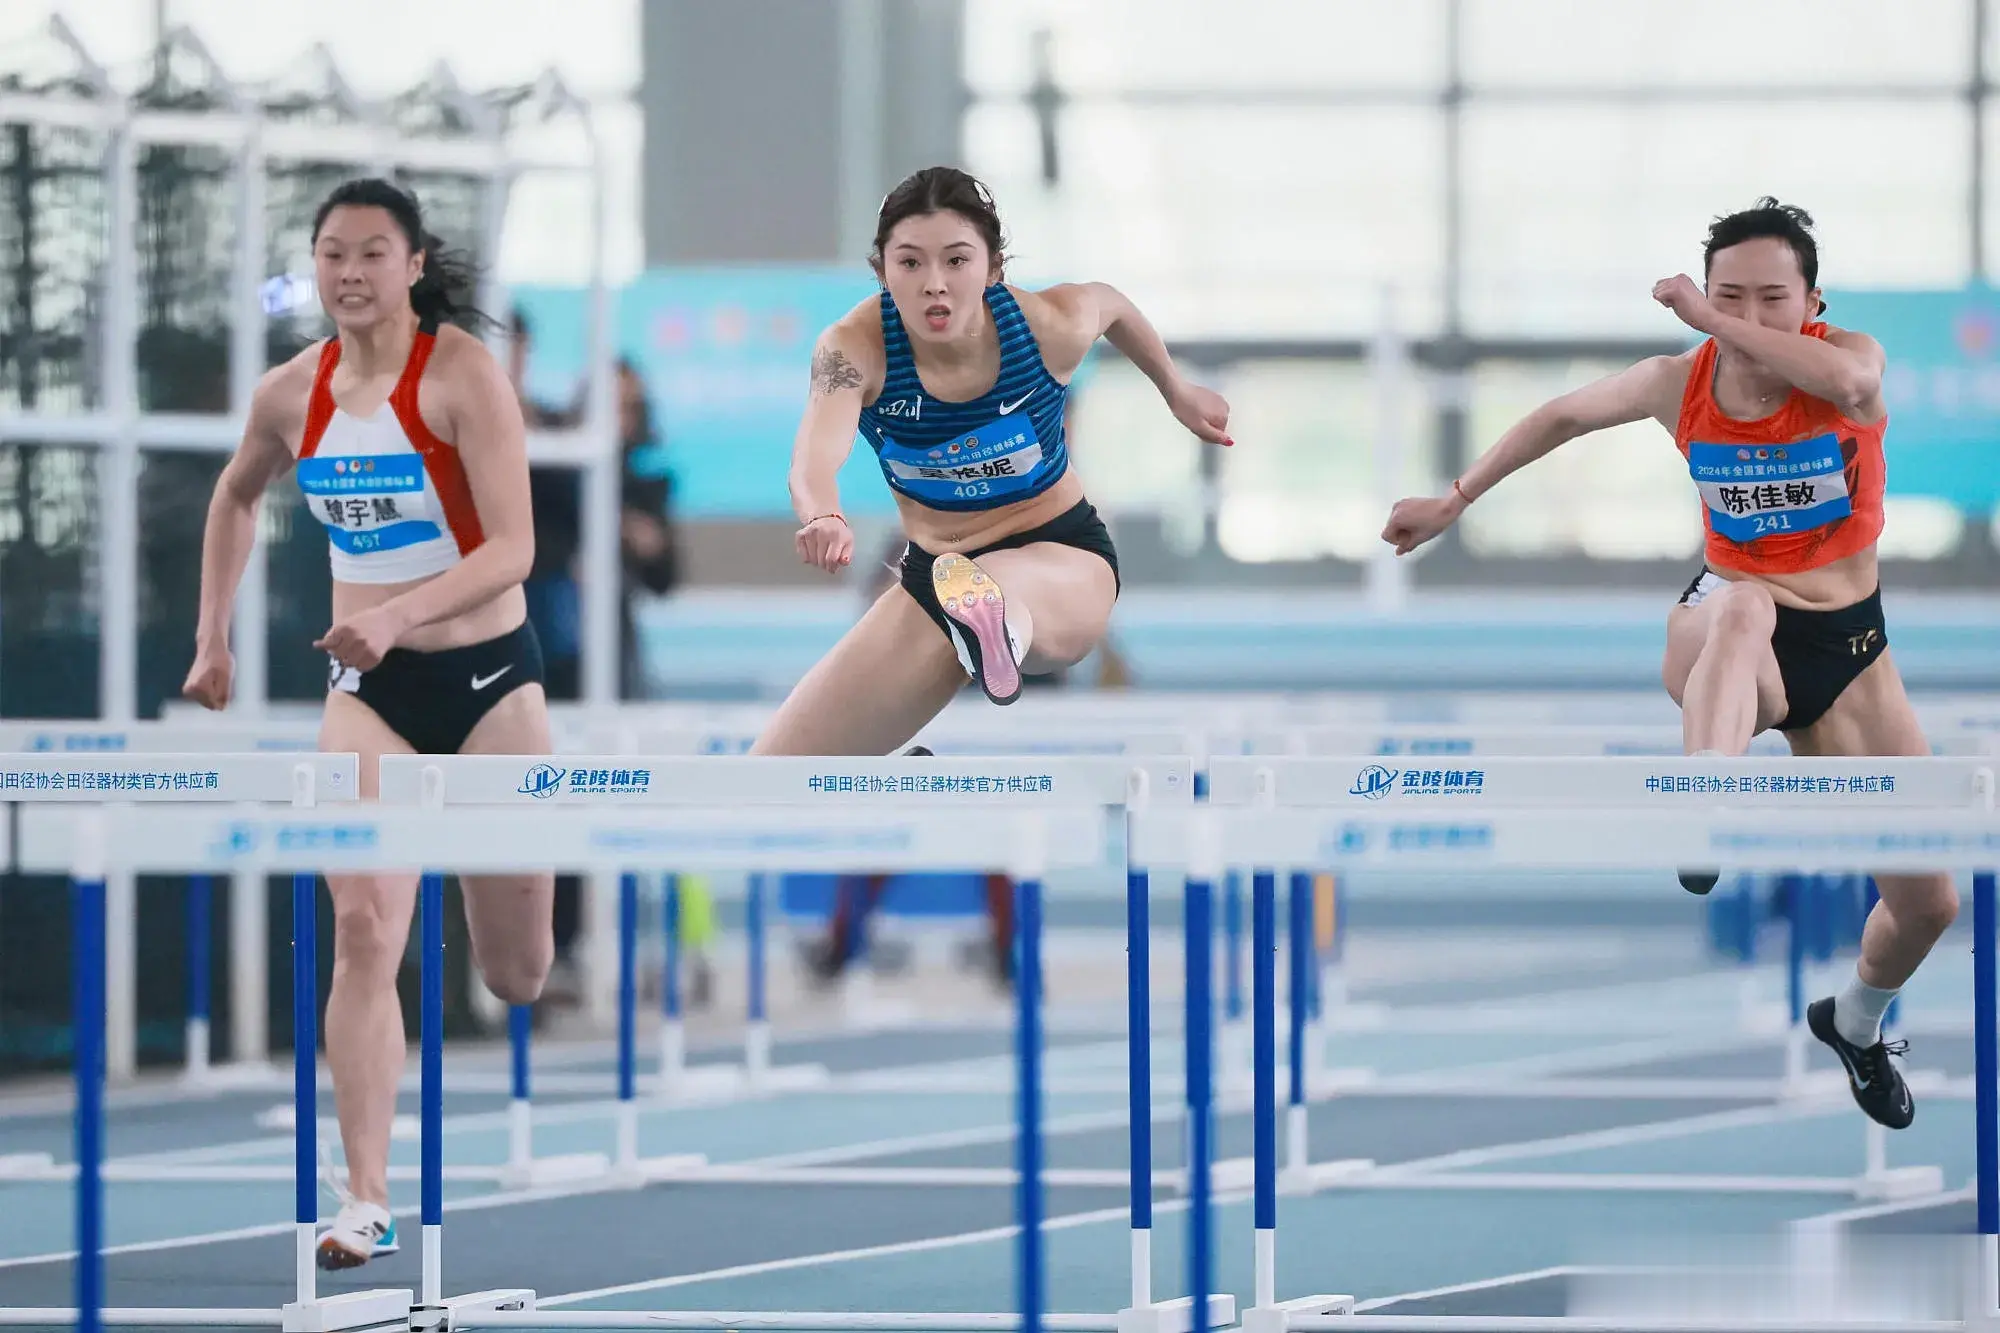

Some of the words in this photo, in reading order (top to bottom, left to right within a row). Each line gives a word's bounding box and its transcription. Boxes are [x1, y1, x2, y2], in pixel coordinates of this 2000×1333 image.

[954, 481, 990, 498] 403
[1719, 481, 1817, 514] 陈佳敏
[1753, 514, 1792, 533] 241
[569, 769, 651, 785] 金陵体育
[808, 774, 1053, 793] 中国田径协会田径器材类官方供应商
[1401, 770, 1485, 787] 金陵体育
[1645, 774, 1896, 793] 中国田径协会田径器材类官方供应商
